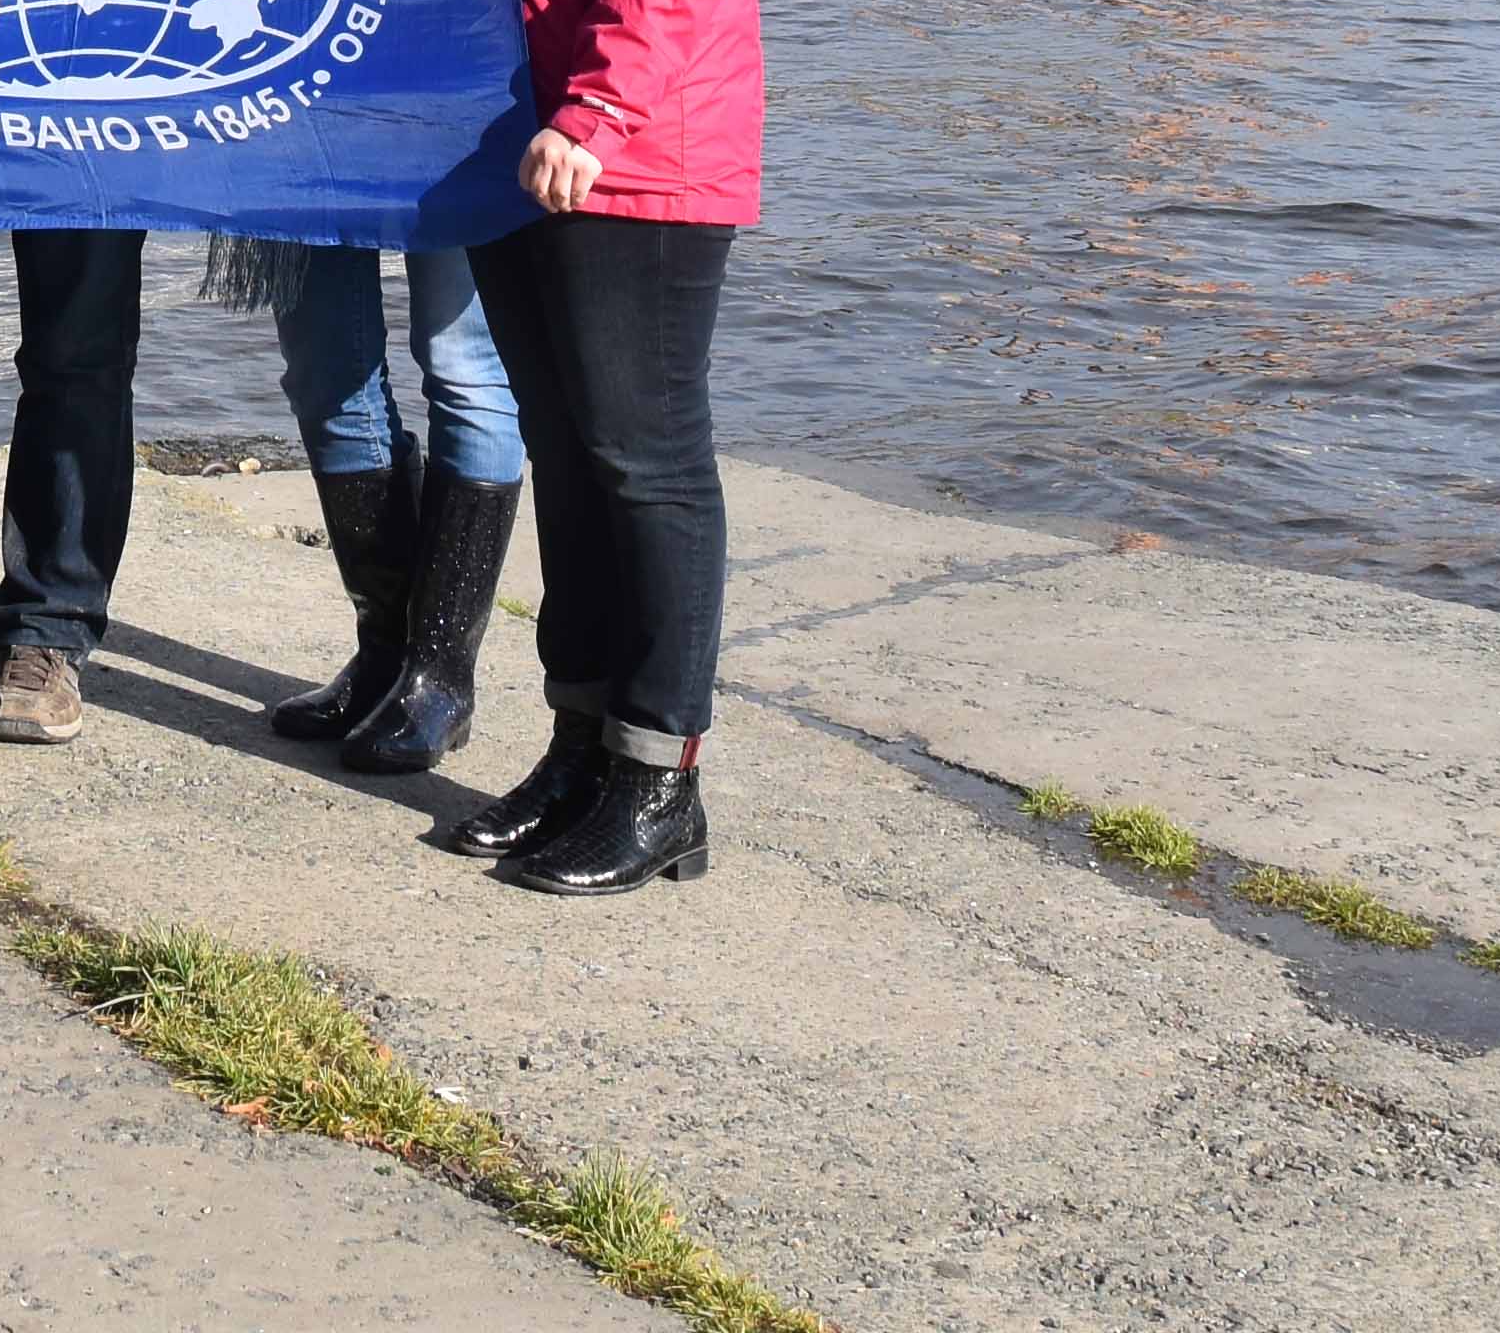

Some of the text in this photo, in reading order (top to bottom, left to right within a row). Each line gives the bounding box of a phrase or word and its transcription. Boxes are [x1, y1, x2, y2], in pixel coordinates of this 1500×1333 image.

[145, 113, 189, 151] В
[193, 92, 291, 145] 1845
[289, 80, 323, 108] г.
